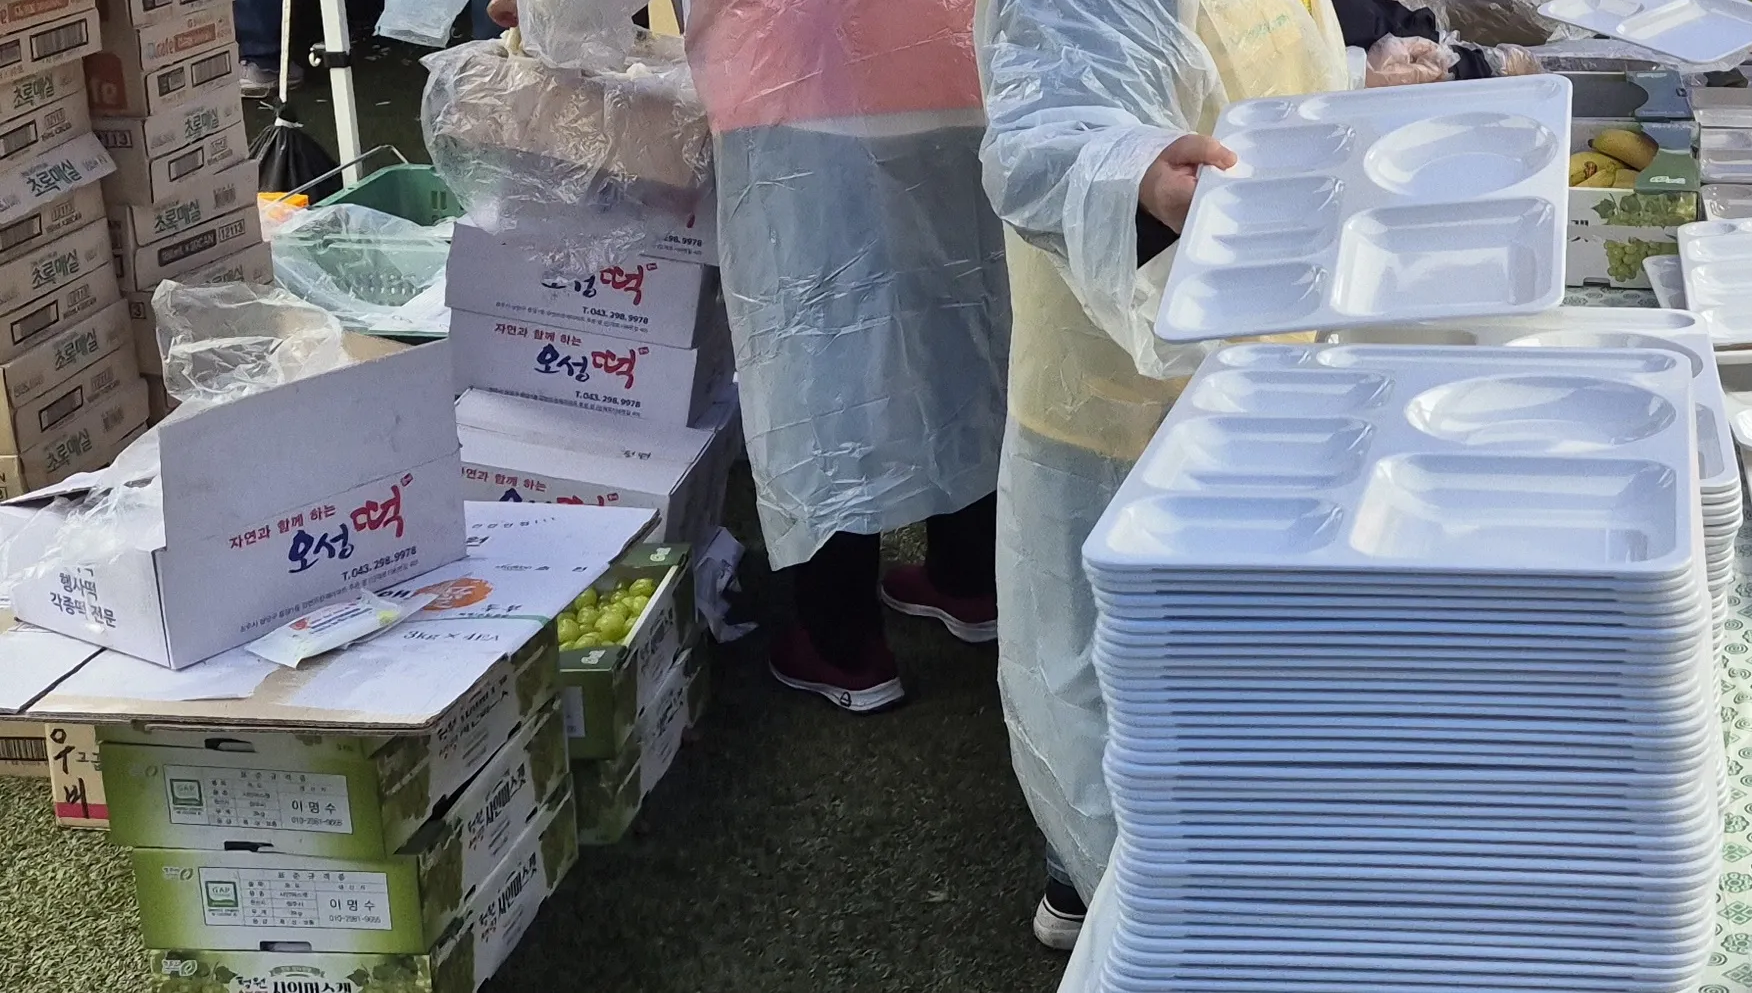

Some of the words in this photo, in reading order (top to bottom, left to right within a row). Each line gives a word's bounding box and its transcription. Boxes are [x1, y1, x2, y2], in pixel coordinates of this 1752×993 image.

[13, 76, 54, 109] 초록매실
[26, 159, 82, 198] 초록매실
[154, 199, 201, 234] 초록매실
[31, 249, 80, 290] 초록매실
[54, 327, 99, 371] 초록매실
[494, 323, 529, 338] 자연과
[533, 329, 555, 343] 함께
[560, 334, 582, 347] 하는
[575, 390, 641, 409] T.043.298.9978
[46, 428, 93, 473] 초록매실
[494, 472, 518, 488] 함께
[523, 477, 547, 492] 하는
[229, 525, 272, 550] 자연과
[277, 512, 304, 535] 함께
[310, 503, 336, 522] 하는
[341, 545, 418, 582] T.043.298.9978
[59, 572, 98, 602] 행사떡
[91, 604, 117, 629] 전문
[211, 886, 231, 894] GAP
